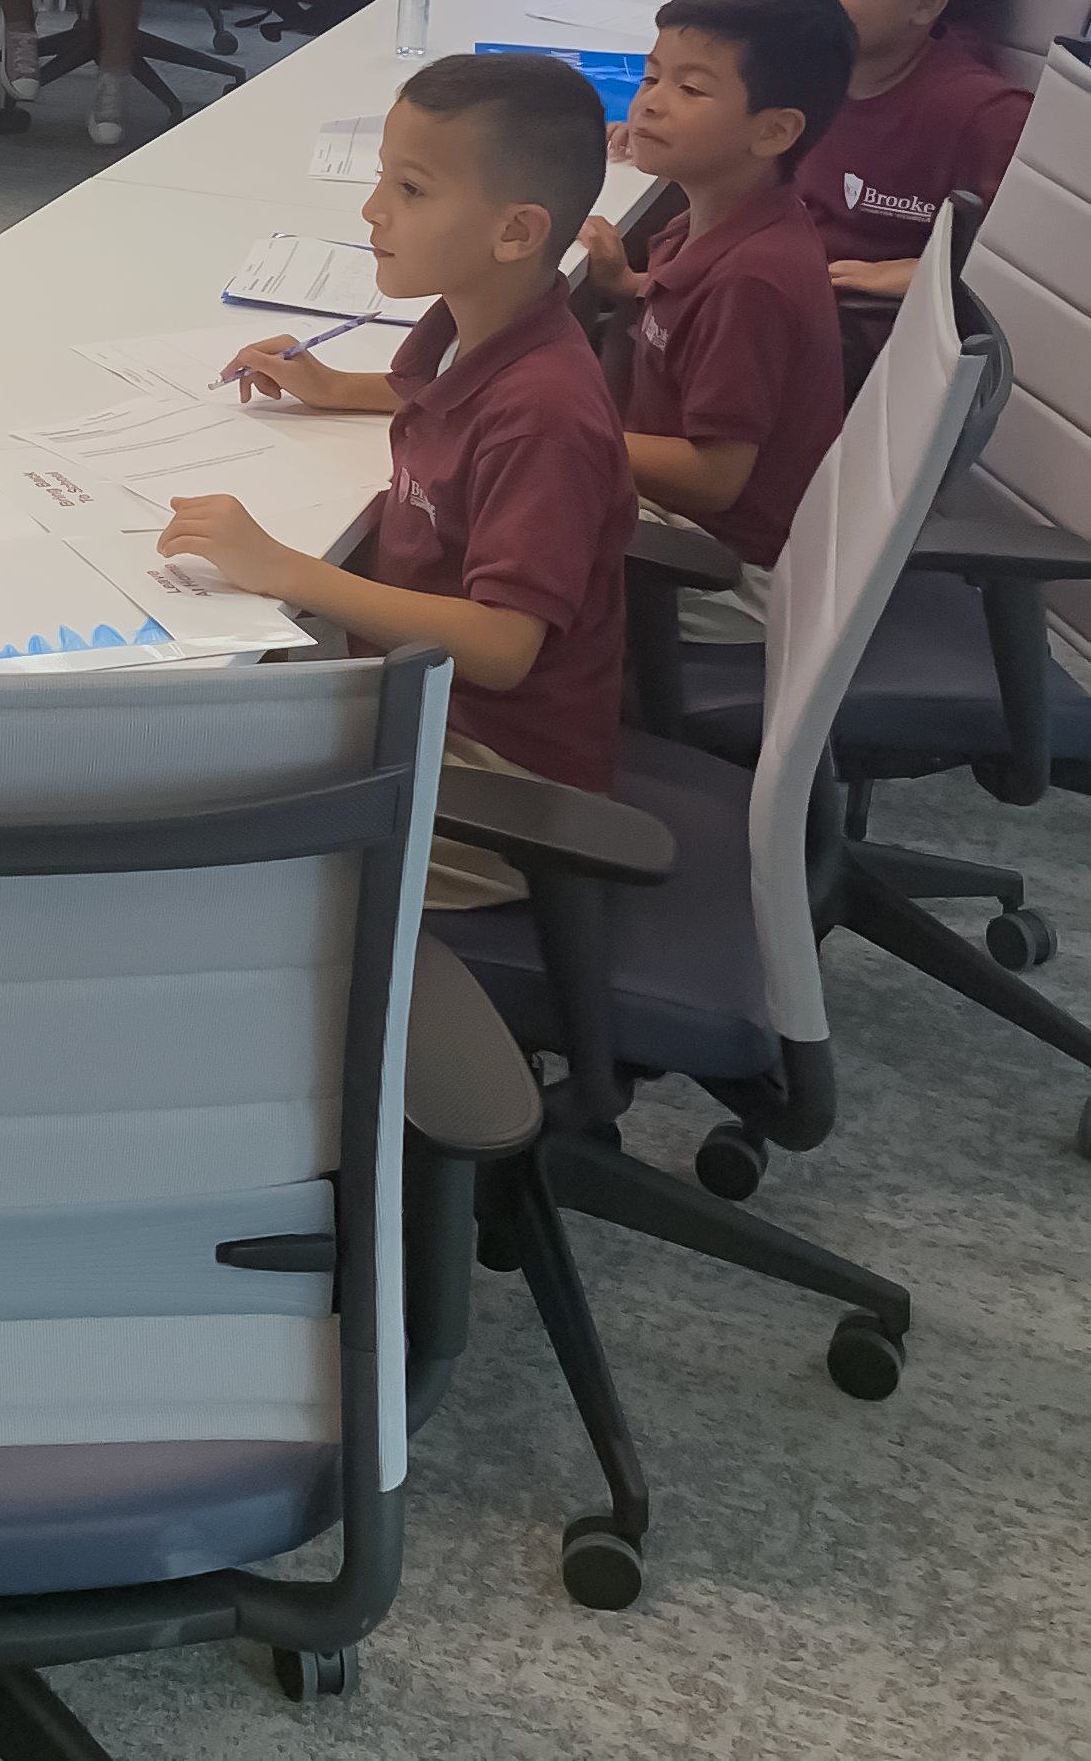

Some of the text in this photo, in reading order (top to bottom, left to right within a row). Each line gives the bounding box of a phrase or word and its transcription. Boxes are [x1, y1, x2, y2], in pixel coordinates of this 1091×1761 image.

[864, 186, 936, 214] Brooke
[23, 471, 76, 507] Bring Back
[78, 493, 95, 504] To
[146, 570, 183, 594] Leave
[164, 563, 199, 587] Home
